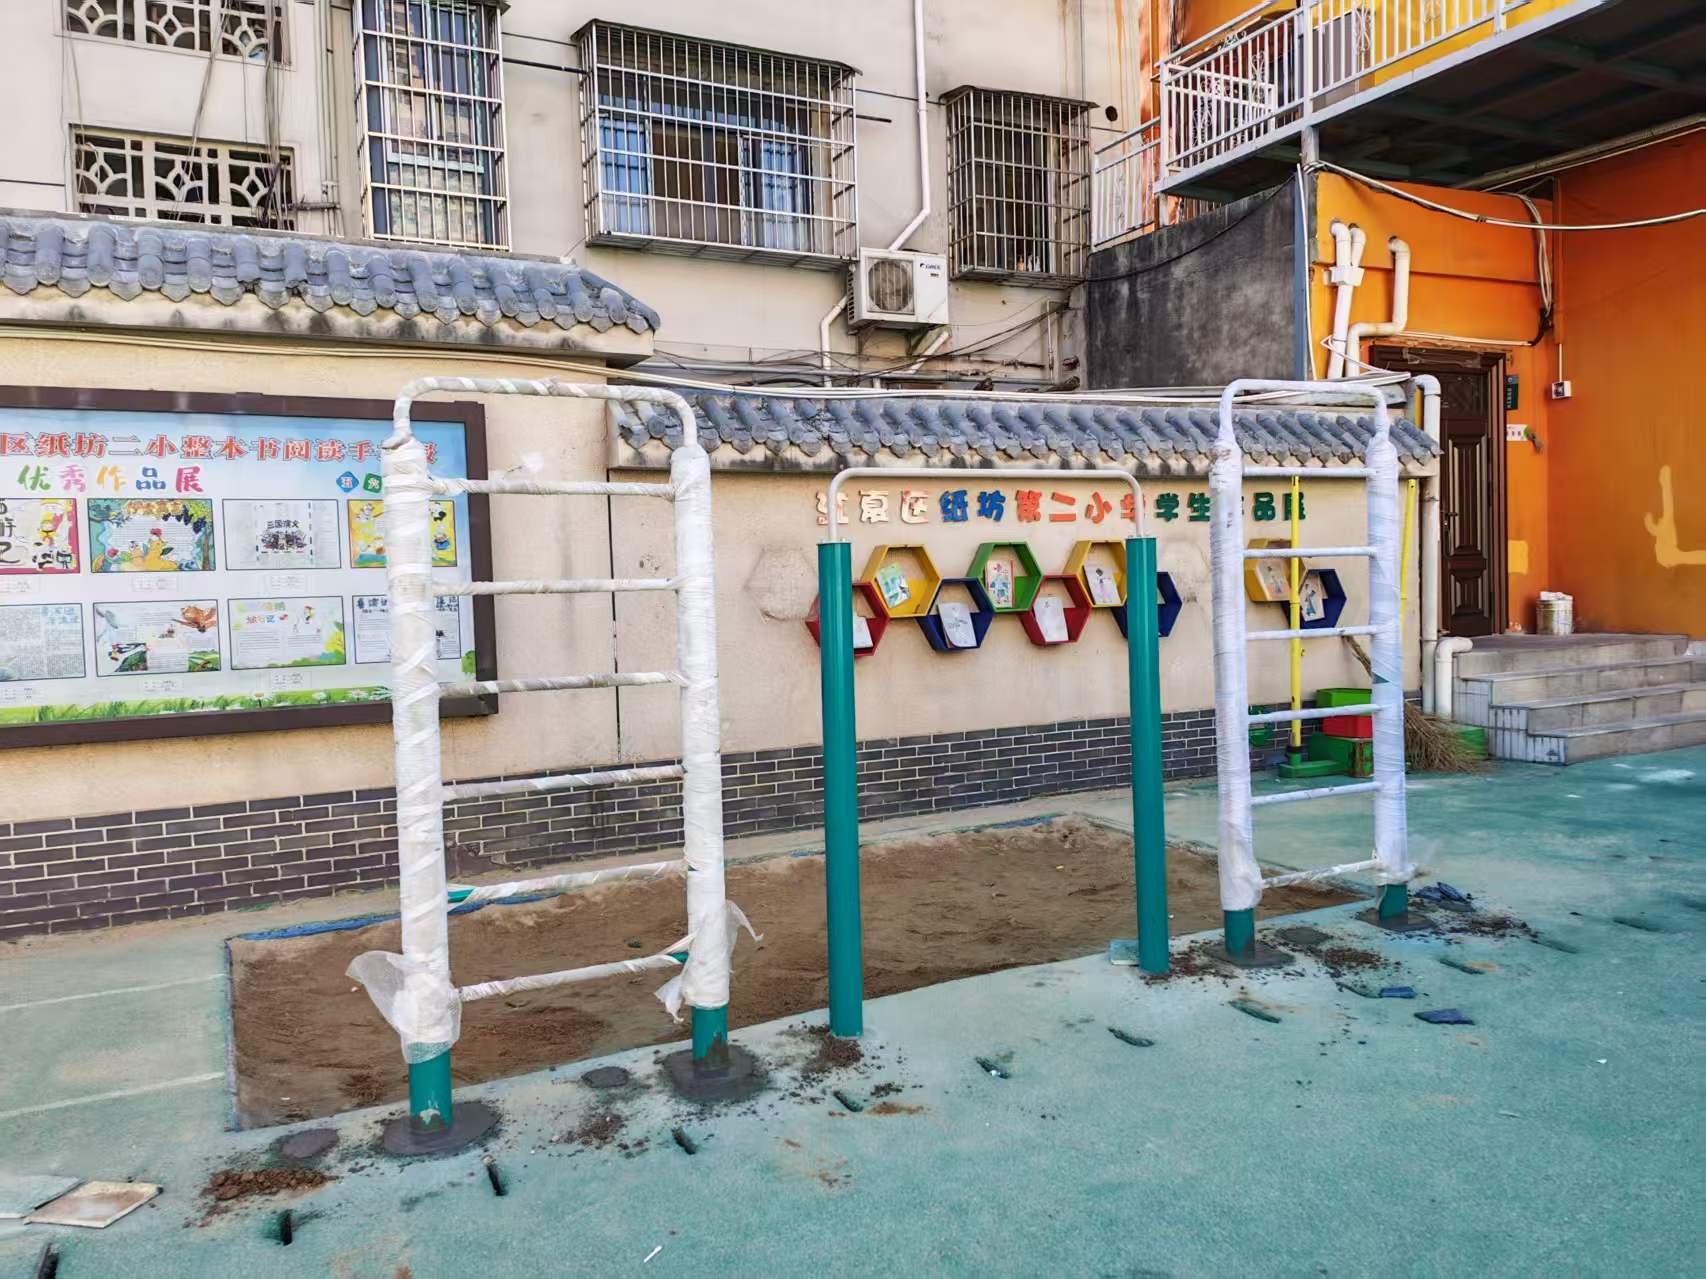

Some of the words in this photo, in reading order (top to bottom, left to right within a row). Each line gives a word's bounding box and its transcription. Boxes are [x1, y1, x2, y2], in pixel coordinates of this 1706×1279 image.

[0, 432, 437, 464] 区纸坊二小整本书阅读手
[17, 464, 204, 493] 优秀作品展
[815, 489, 1307, 526] 江夏区纸坊第二小学学生品展
